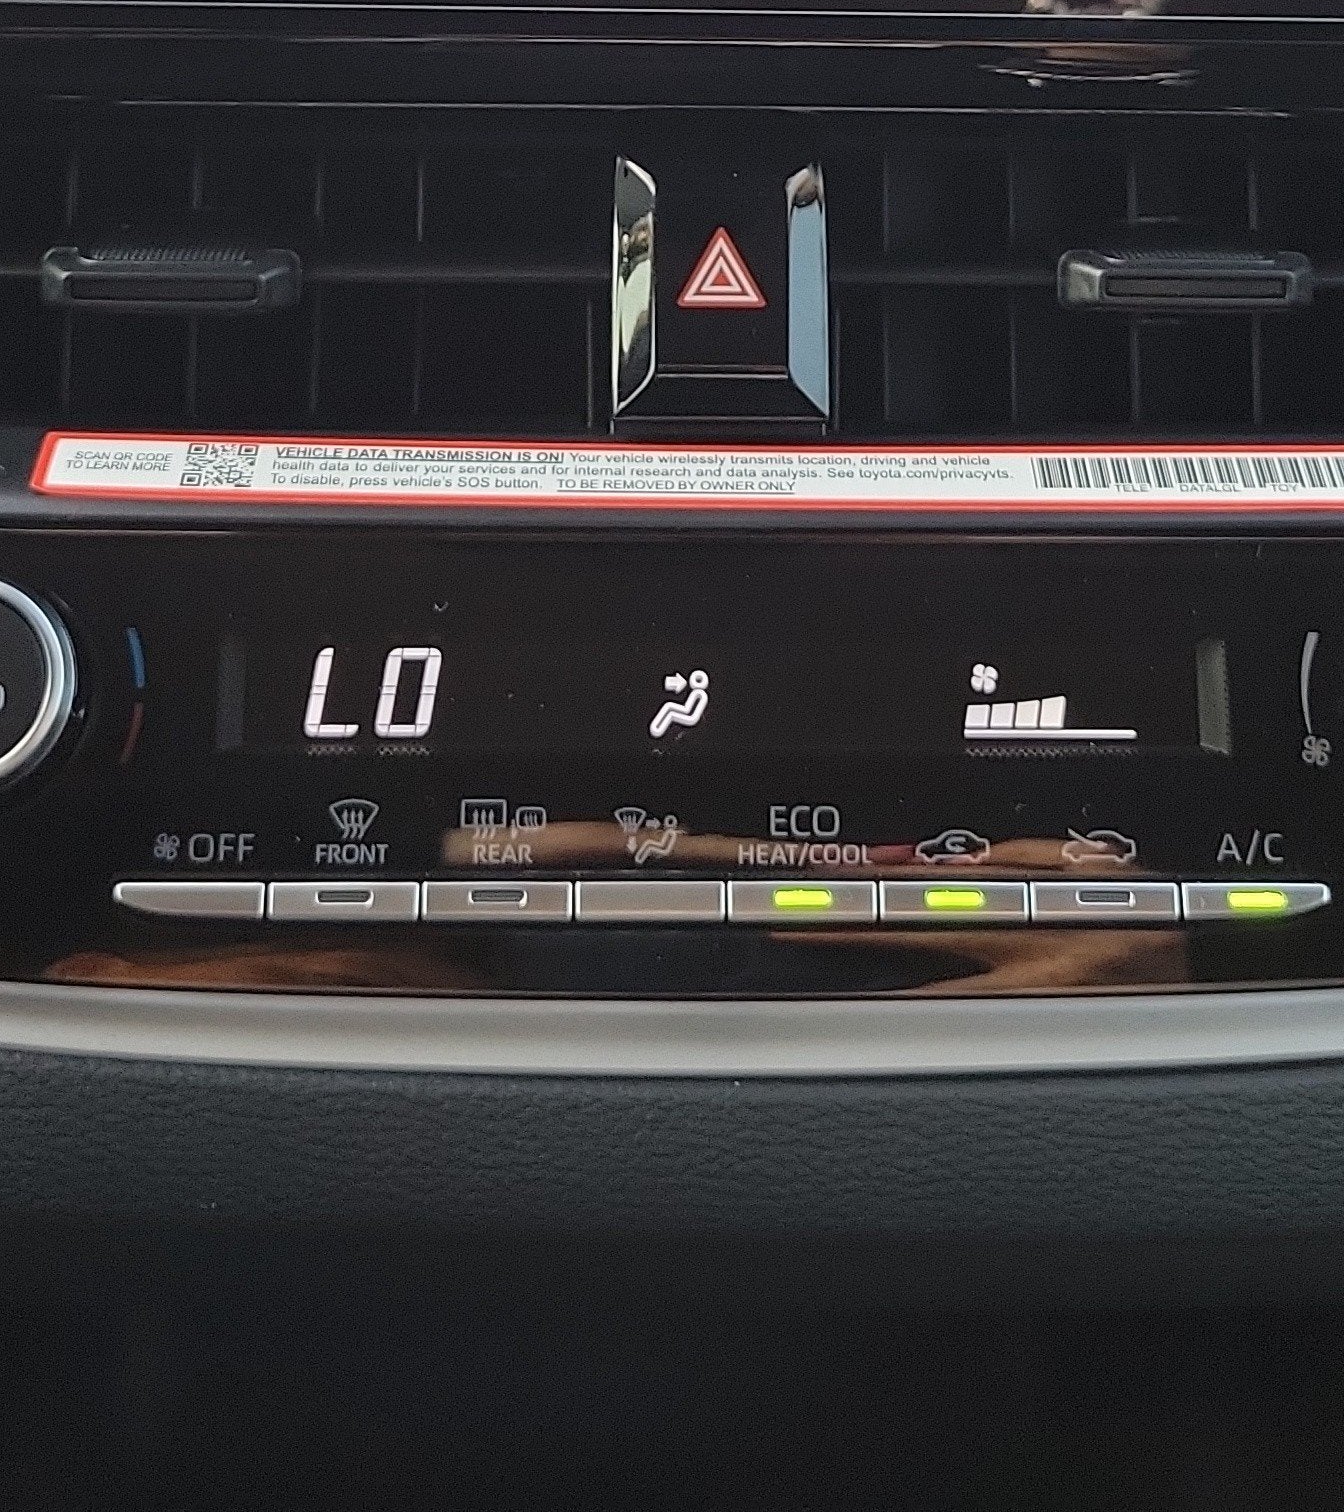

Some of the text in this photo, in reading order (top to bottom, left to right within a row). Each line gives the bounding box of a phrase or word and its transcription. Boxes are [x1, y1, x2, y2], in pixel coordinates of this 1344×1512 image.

[66, 459, 171, 471] TO LEARN MORE
[75, 450, 173, 462] SCAN QR CODE
[276, 446, 343, 458] VEHICLE
[348, 448, 388, 459] DATA
[393, 449, 512, 461] TRANSMISSION
[518, 452, 531, 462] IS
[569, 452, 601, 463] Your
[605, 453, 654, 464] vehicle
[657, 454, 726, 466] wirelessly
[731, 455, 794, 465] transmits
[798, 455, 856, 467] location,
[860, 456, 906, 467] driving
[911, 456, 937, 466] and
[942, 456, 990, 466] vehicle
[272, 460, 1014, 481] health data to deliver your services and for internal research and data analysis. See toyota.com/privacyvts.
[271, 473, 796, 492] To disable, press vehicle's SOS button. TO BE REMOVED BY OWNER ONLY
[1114, 483, 1149, 493] TELE
[303, 647, 443, 738] LO
[768, 805, 841, 838] ECO
[188, 832, 255, 863] OFF
[315, 843, 389, 866] FRONT
[472, 843, 534, 865] REAR
[737, 843, 874, 867] HEAT/COOL
[1215, 830, 1285, 865] A/C
